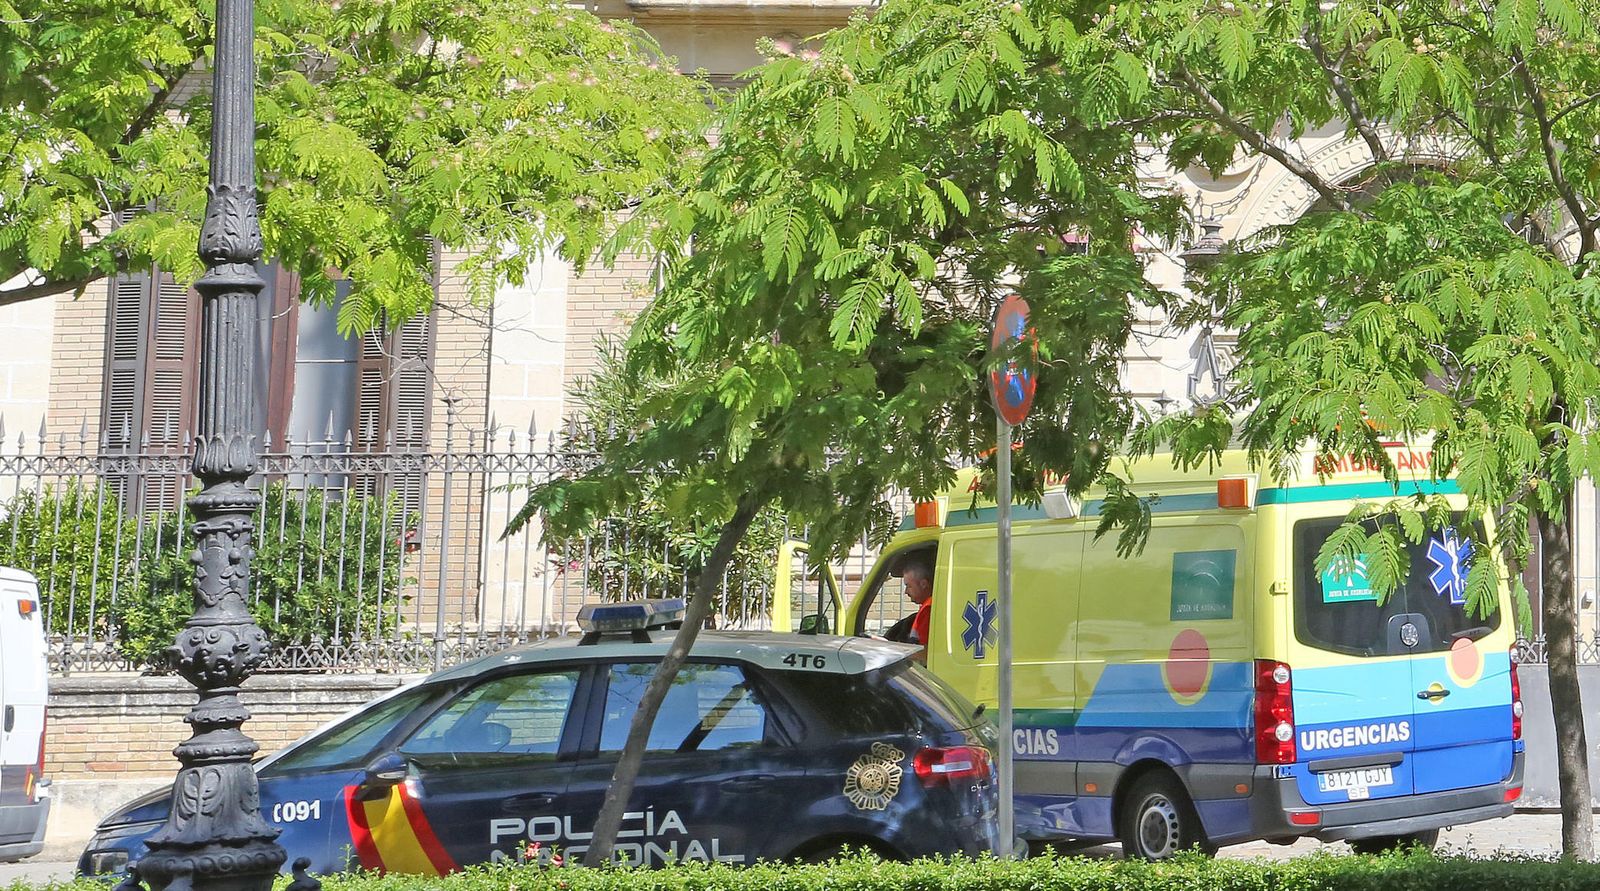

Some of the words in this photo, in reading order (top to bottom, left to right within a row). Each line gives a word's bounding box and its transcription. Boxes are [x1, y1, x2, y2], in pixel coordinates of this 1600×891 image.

[1313, 450, 1458, 475] AMBUAN
[783, 653, 826, 669] 4T6
[1013, 728, 1060, 755] CIAS
[1300, 721, 1410, 751] URGENCIAS
[1328, 771, 1361, 788] 8121
[1365, 767, 1388, 784] GJY
[1349, 787, 1367, 798] SP
[490, 805, 689, 845] POLCÍA
[490, 838, 746, 869] NACONAL
